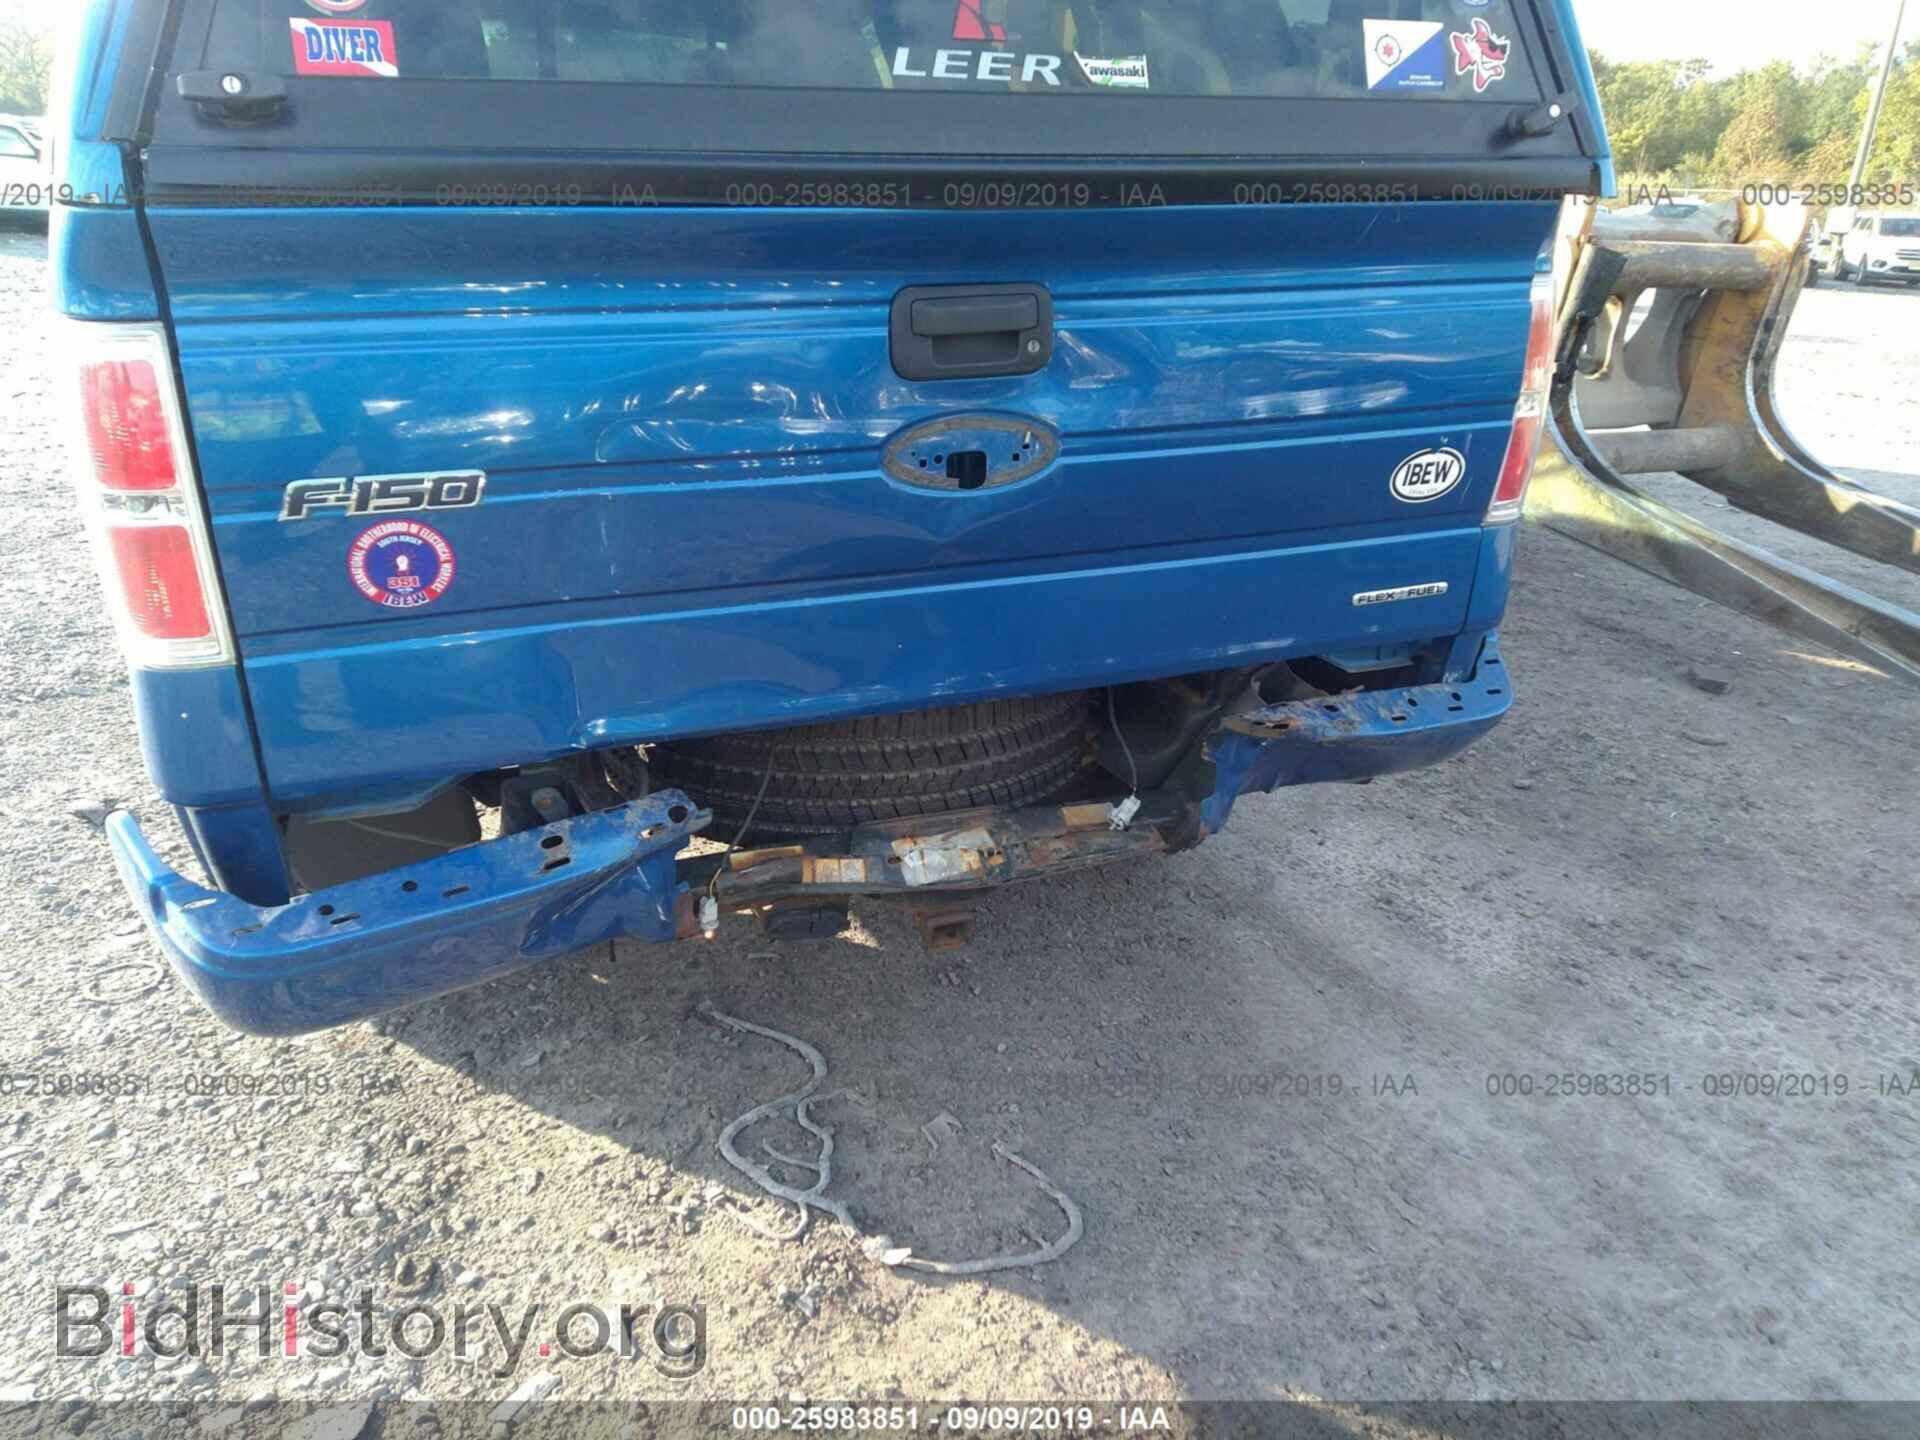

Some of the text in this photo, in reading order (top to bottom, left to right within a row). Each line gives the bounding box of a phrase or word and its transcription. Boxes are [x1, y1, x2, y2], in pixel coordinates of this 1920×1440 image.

[304, 26, 384, 62] DIVER
[892, 47, 1061, 86] LEER
[1084, 62, 1146, 78] awasaki
[1402, 459, 1455, 487] IBEW
[278, 469, 486, 521] F-150
[1358, 585, 1444, 603] FLEX FUEL
